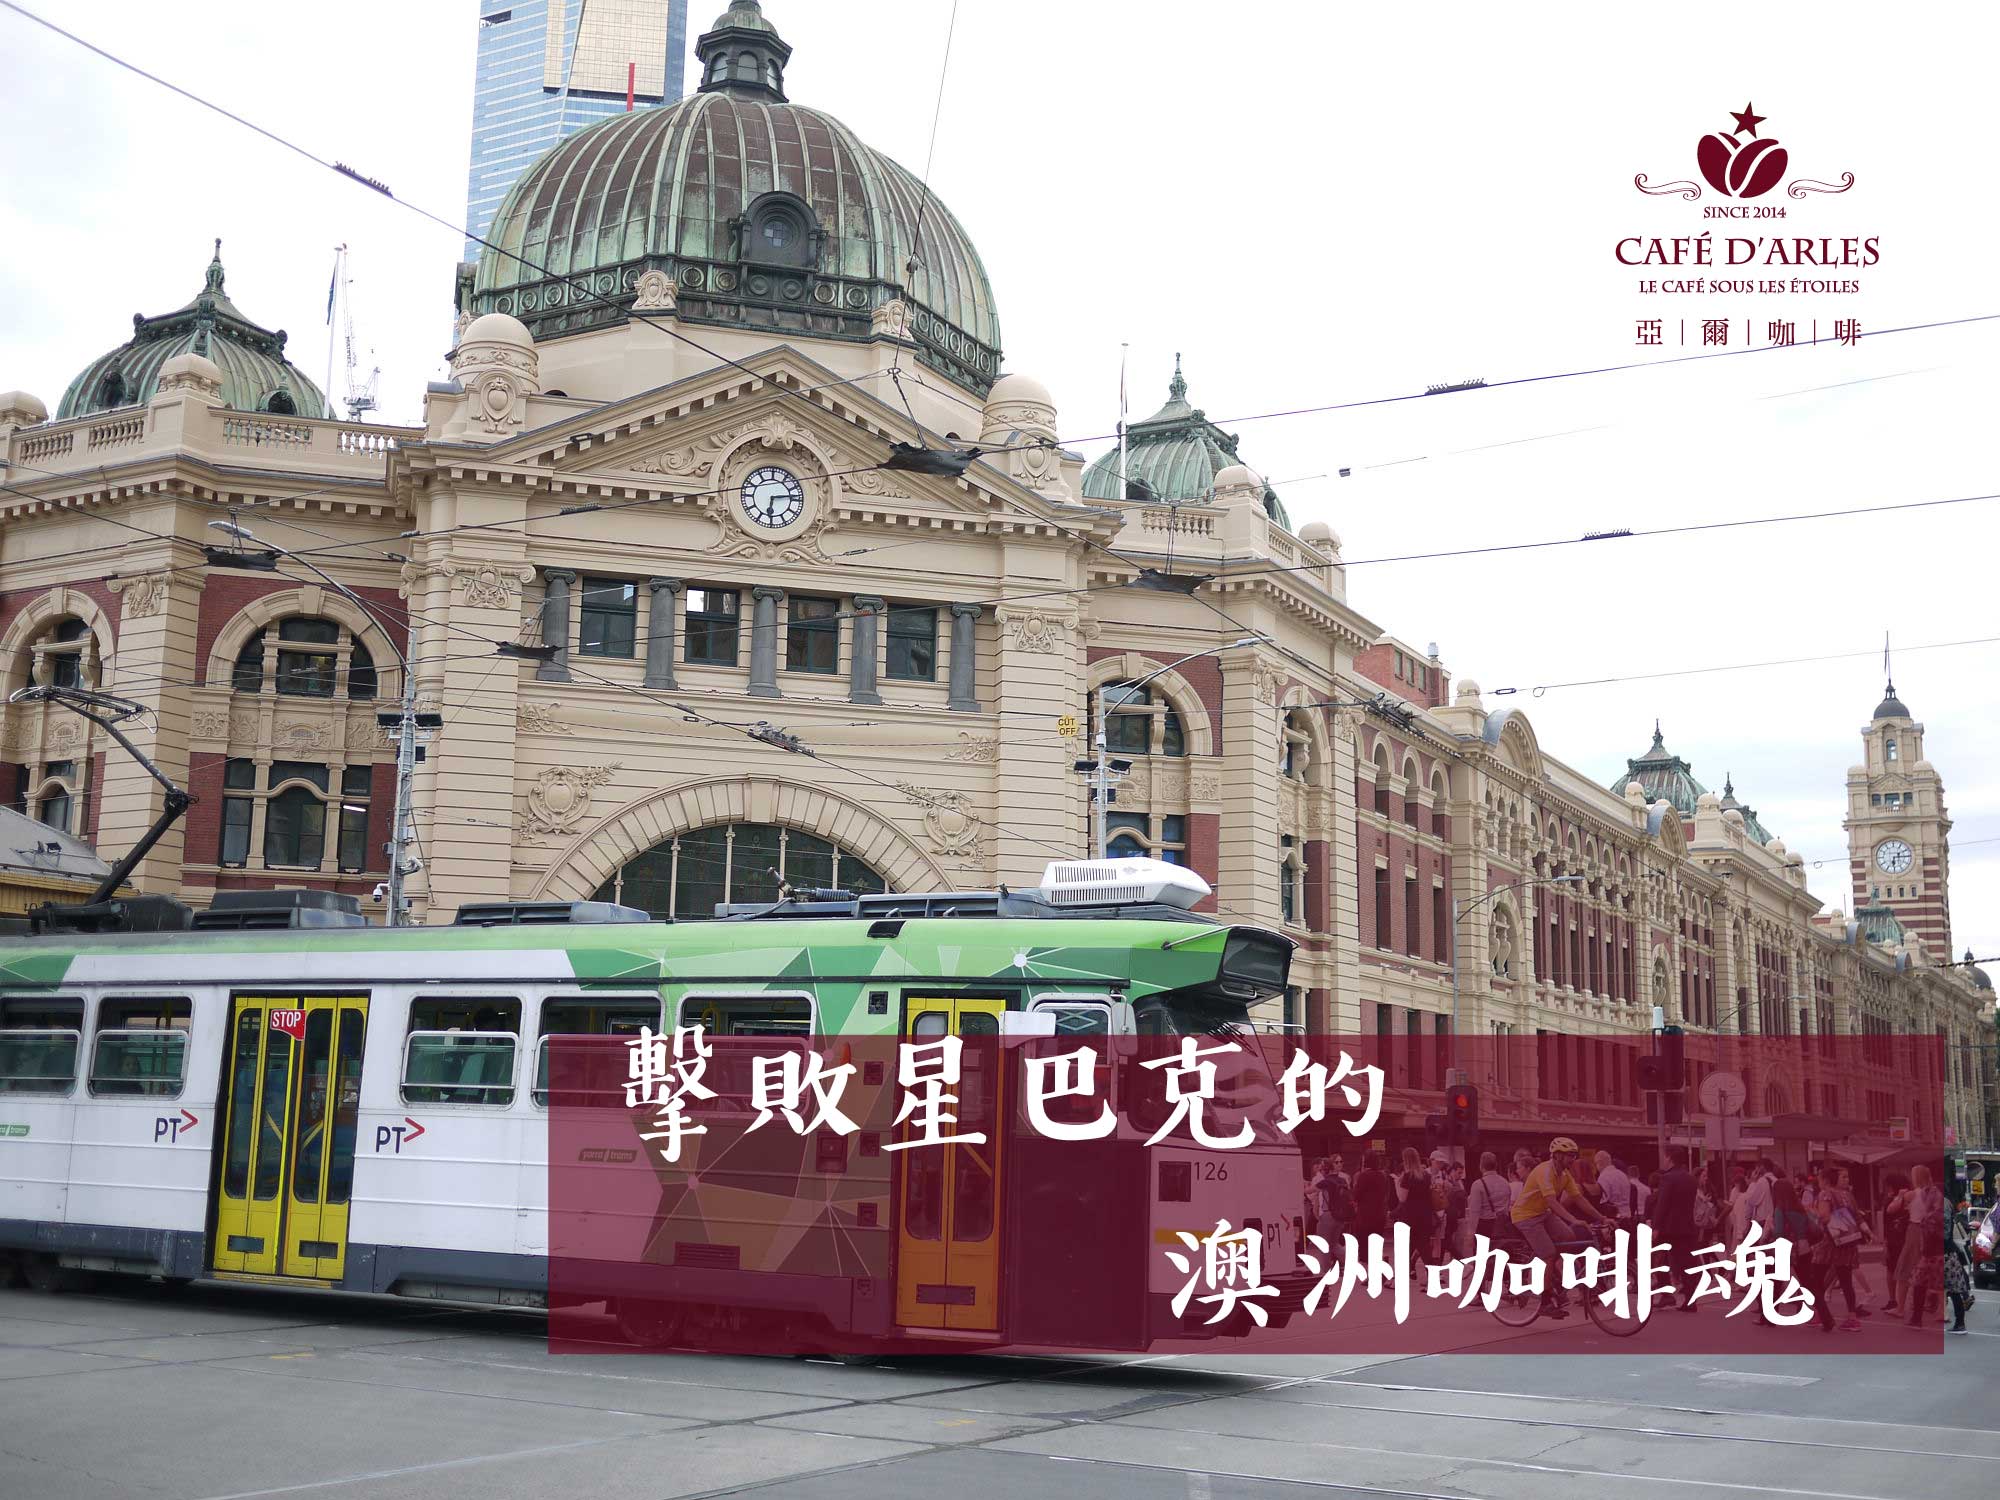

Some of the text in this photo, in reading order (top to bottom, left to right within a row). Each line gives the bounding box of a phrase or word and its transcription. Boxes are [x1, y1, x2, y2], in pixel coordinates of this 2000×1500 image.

[1058, 718, 1075, 726] CUT
[1059, 728, 1076, 736] OFF
[271, 1011, 301, 1028] STOP
[1194, 1162, 1228, 1181] 126
